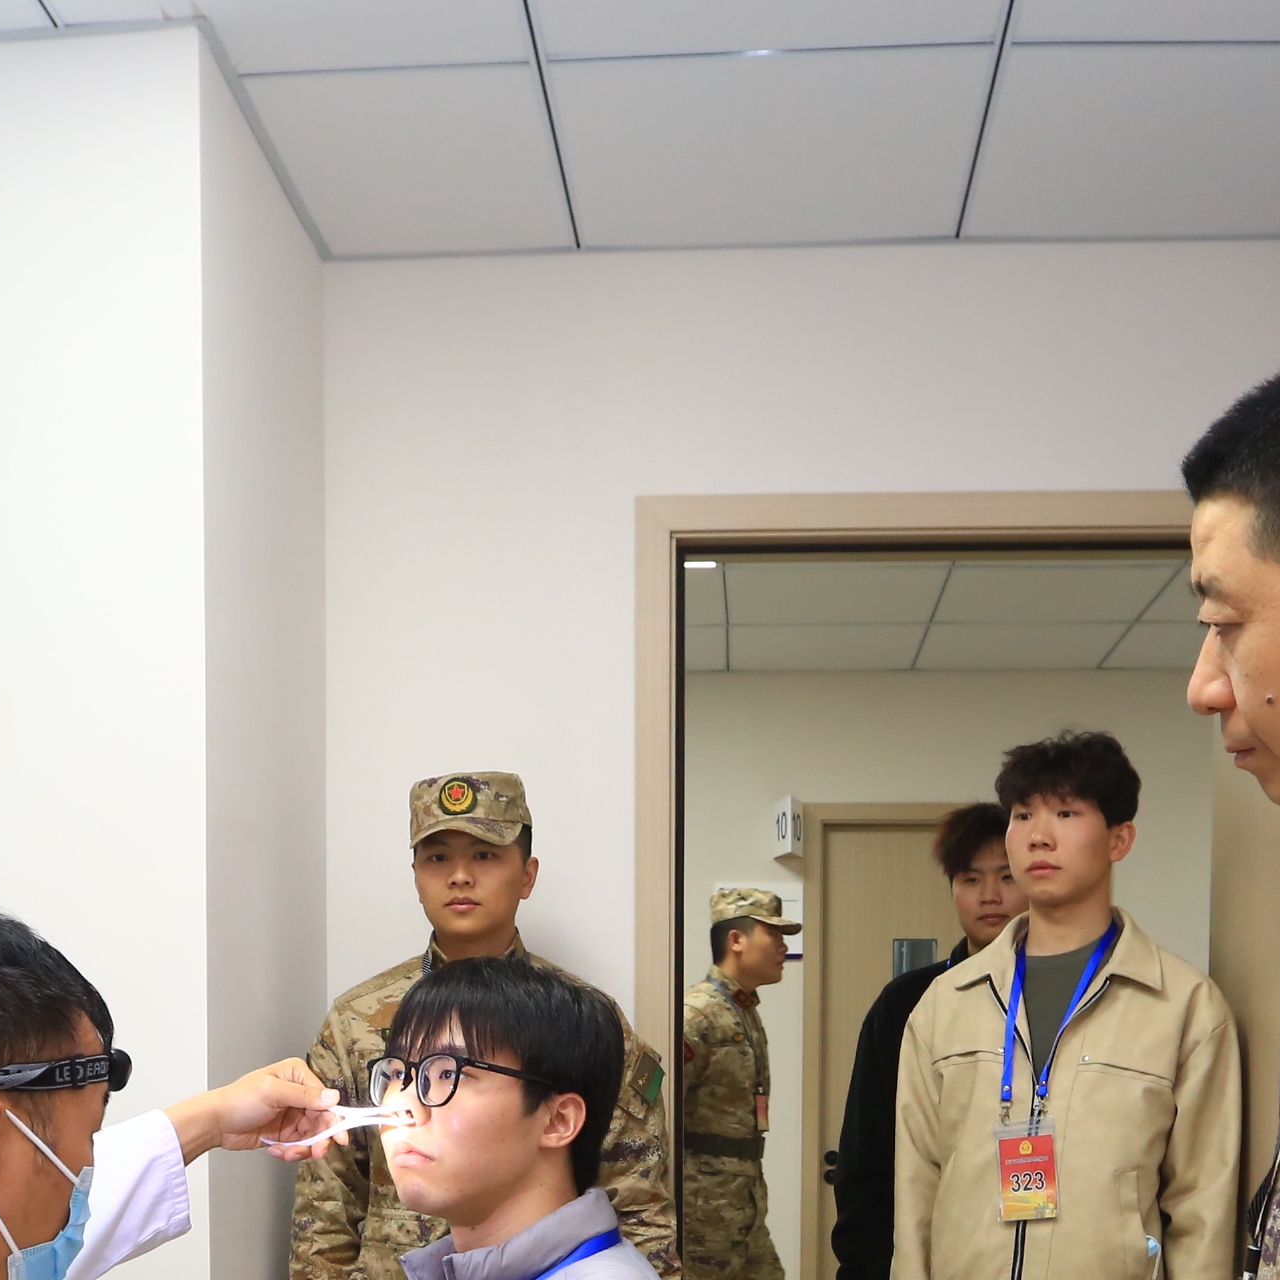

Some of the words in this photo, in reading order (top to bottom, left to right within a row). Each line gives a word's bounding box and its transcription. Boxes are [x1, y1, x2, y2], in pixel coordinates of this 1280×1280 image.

[775, 811, 787, 842] 10
[791, 811, 802, 842] 10
[1010, 1170, 1046, 1194] 323
